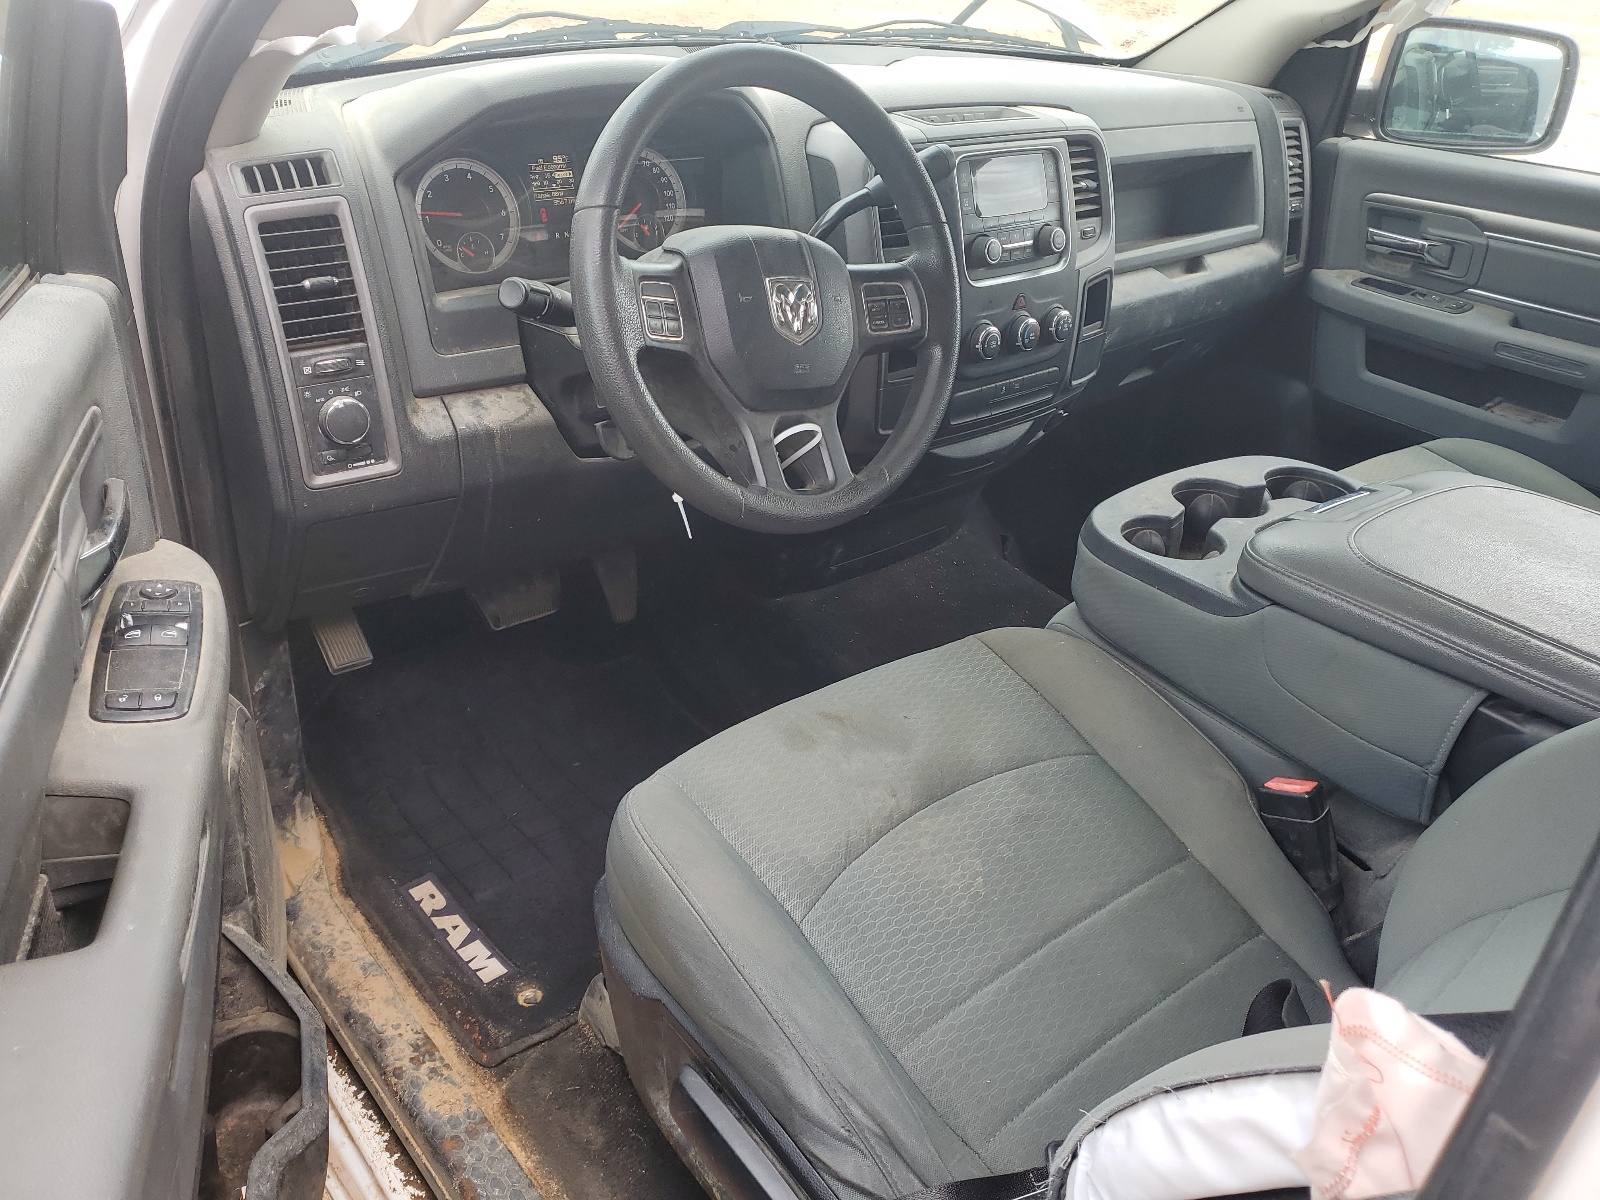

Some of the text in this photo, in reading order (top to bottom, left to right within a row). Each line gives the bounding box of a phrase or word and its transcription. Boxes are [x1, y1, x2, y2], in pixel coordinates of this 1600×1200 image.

[443, 174, 450, 182] 3
[466, 172, 473, 180] 4
[488, 185, 494, 193] 5
[663, 189, 674, 197] 100
[426, 190, 433, 198] 2
[665, 202, 676, 210] 110
[501, 209, 506, 217] 6
[663, 214, 674, 222] 120
[499, 233, 504, 241] 7
[436, 239, 443, 247] 0
[408, 880, 509, 984] RAM
